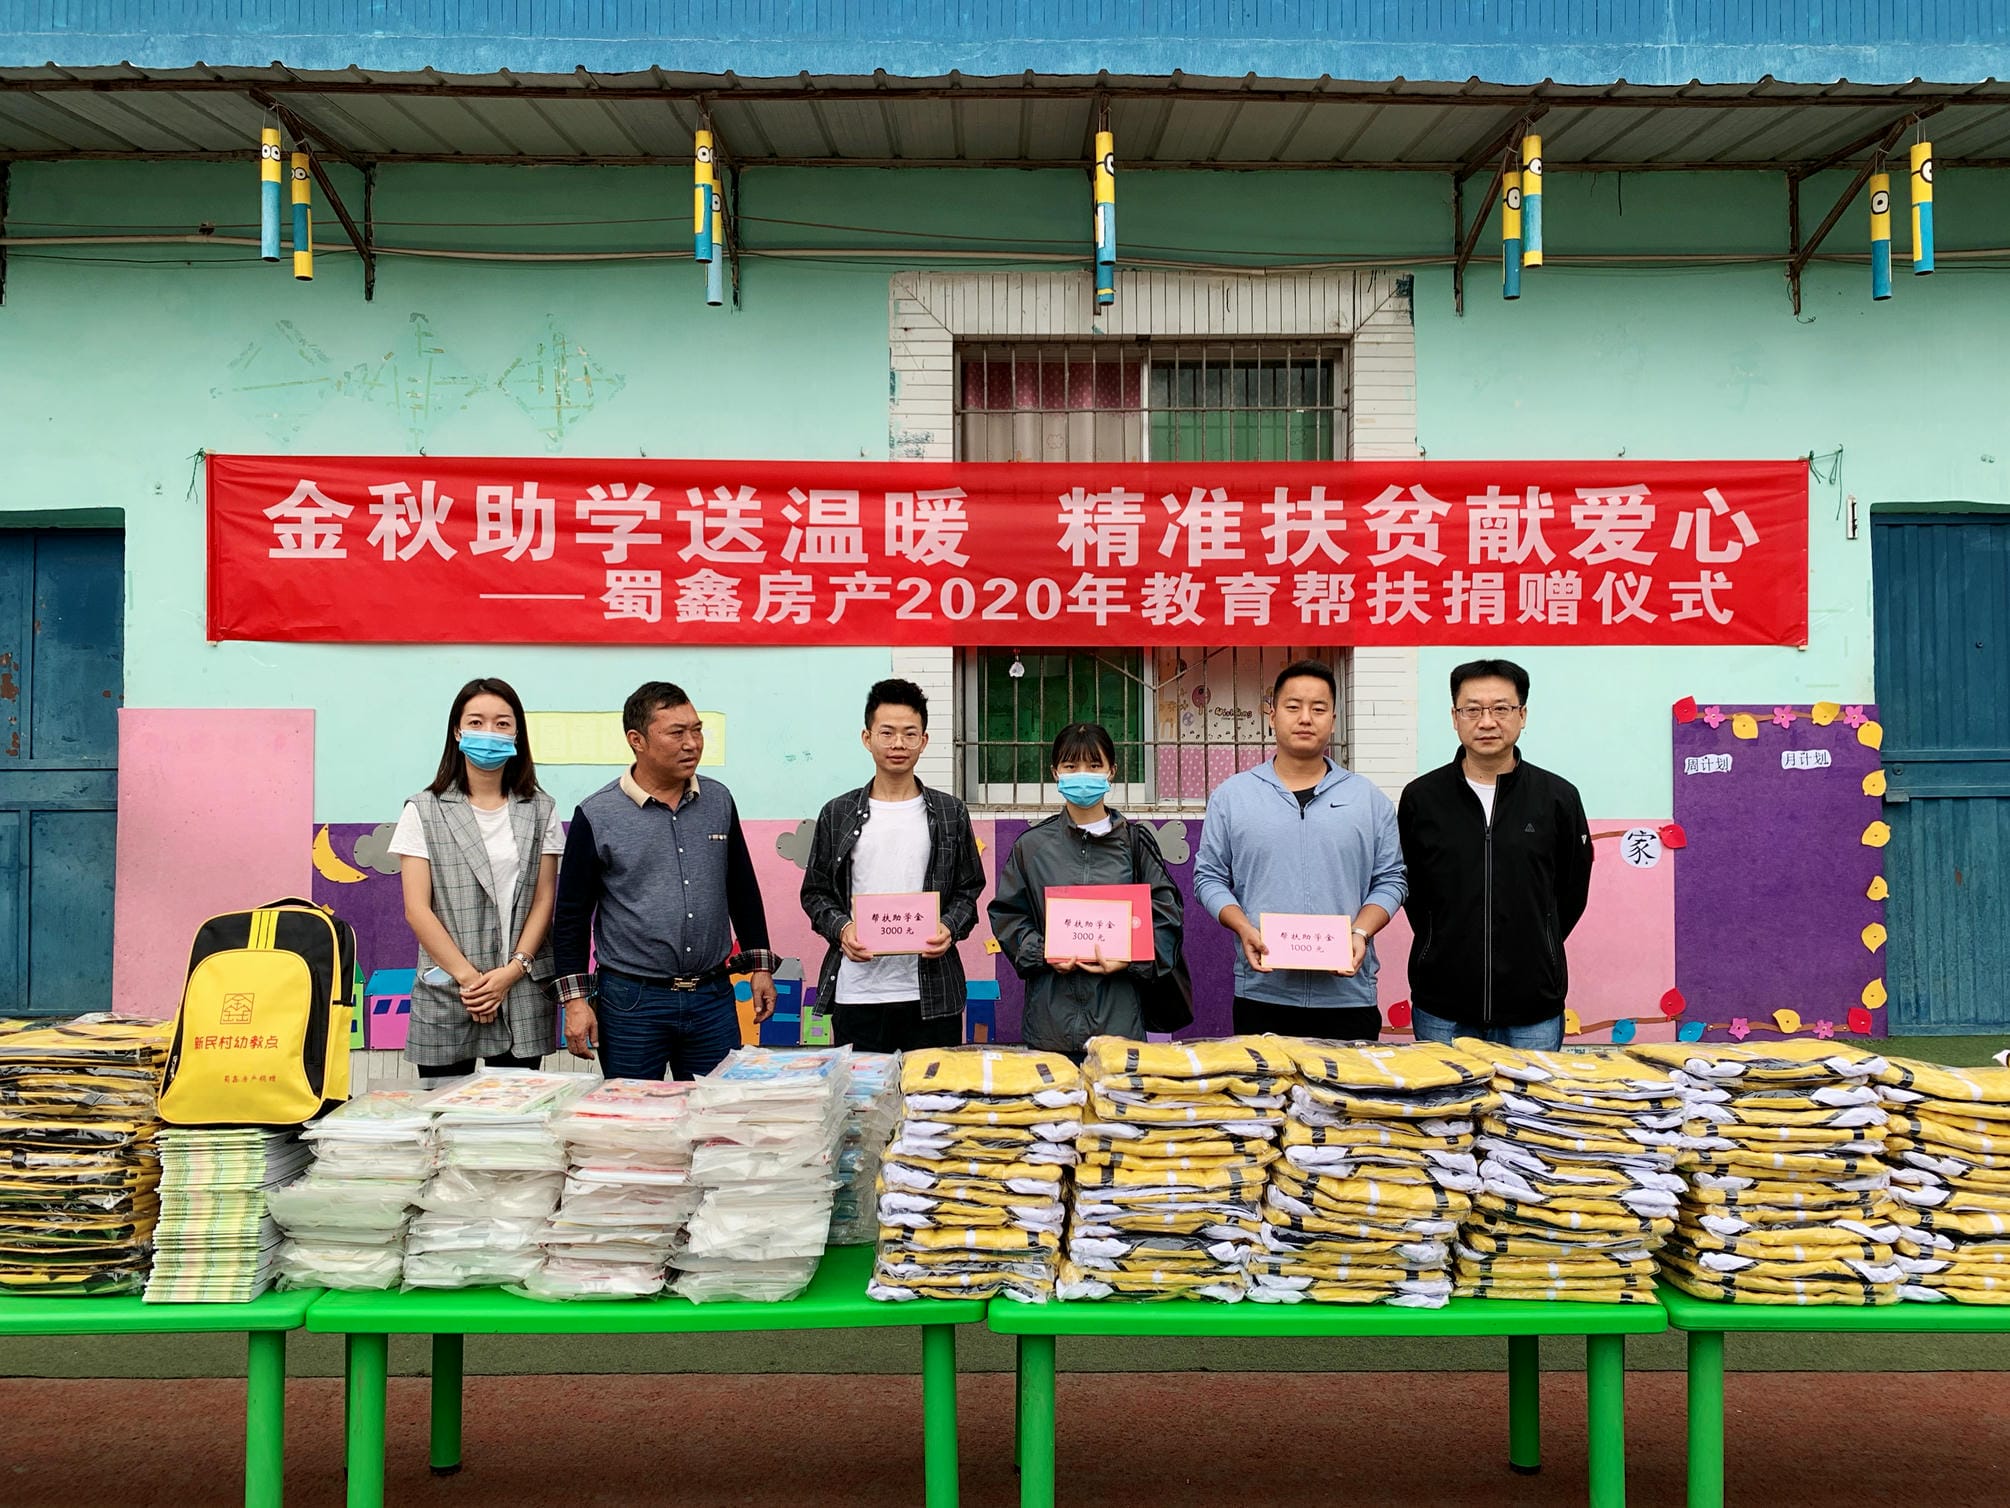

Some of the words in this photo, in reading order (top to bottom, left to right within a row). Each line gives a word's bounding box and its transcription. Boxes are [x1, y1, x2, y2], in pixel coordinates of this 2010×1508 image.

[263, 479, 969, 567] 金秋助学送温暖
[1057, 483, 1760, 567] 精准扶贫献爱心
[1686, 756, 1729, 772] 周计划
[1784, 751, 1829, 766] 月计划
[1627, 830, 1657, 866] 家
[871, 912, 925, 924] 帮扶助学金
[1064, 918, 1116, 929] 帮扶助学金
[881, 926, 903, 935] 3000
[905, 927, 915, 935] 元
[1072, 932, 1095, 941] 3000
[1291, 943, 1313, 952] 1000
[194, 1035, 279, 1050] 新民村幼教点
